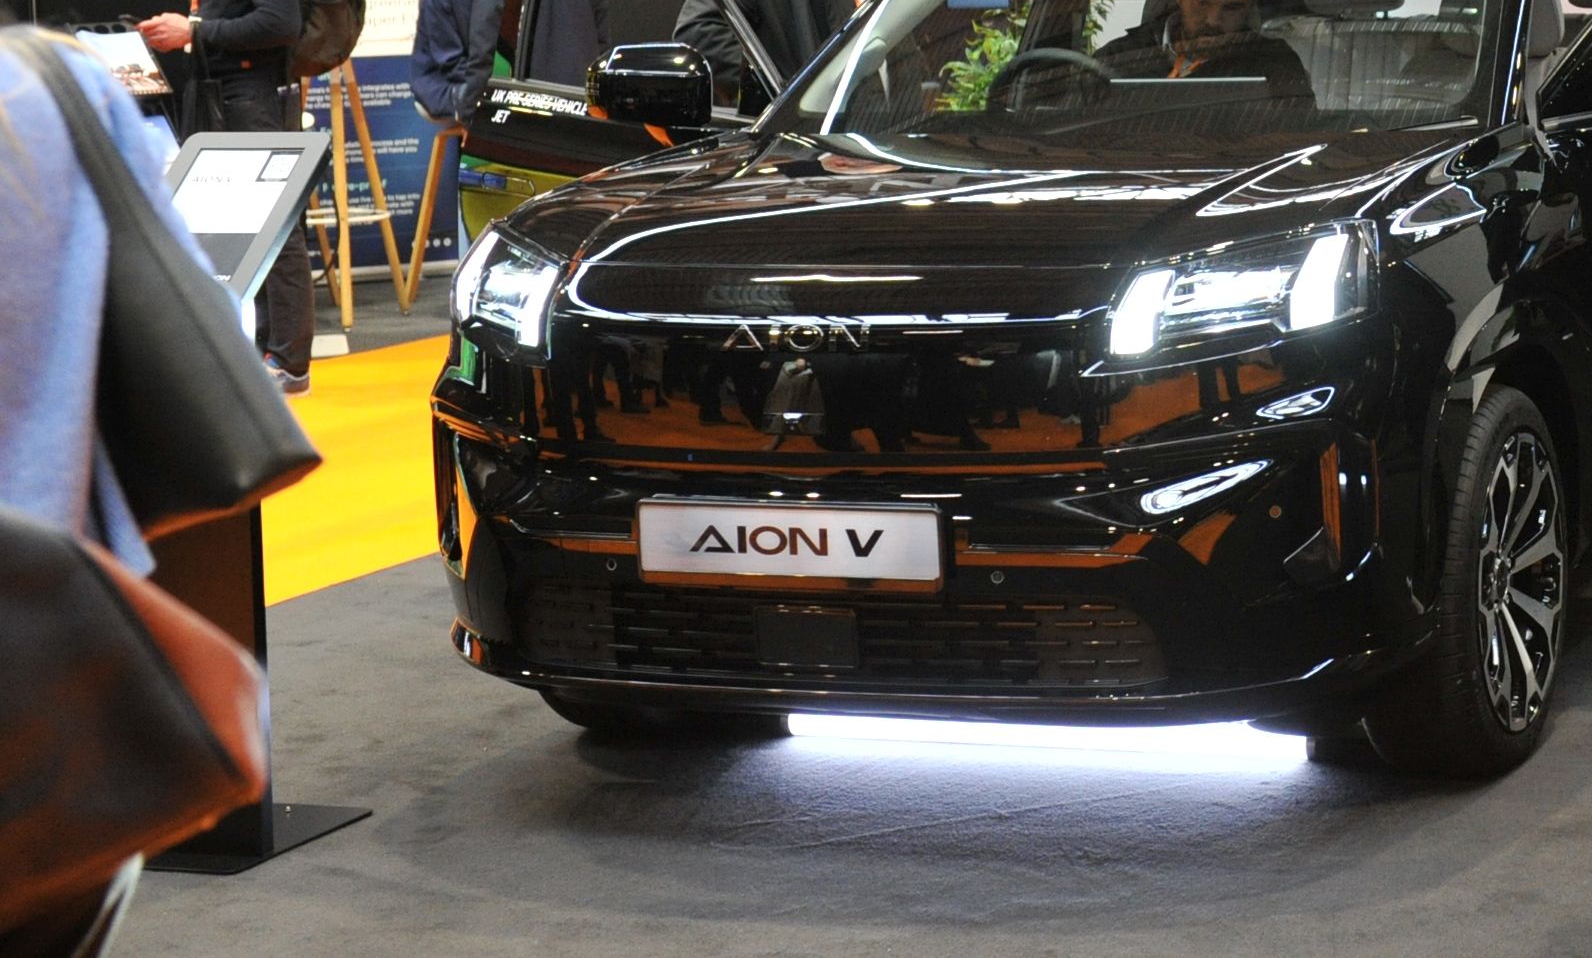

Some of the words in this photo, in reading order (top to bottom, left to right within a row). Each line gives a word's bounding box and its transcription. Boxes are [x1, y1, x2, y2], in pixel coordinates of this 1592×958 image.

[491, 89, 507, 103] UK
[491, 109, 511, 124] JET
[722, 323, 871, 353] AION
[689, 524, 829, 556] AION
[845, 529, 884, 557] V
